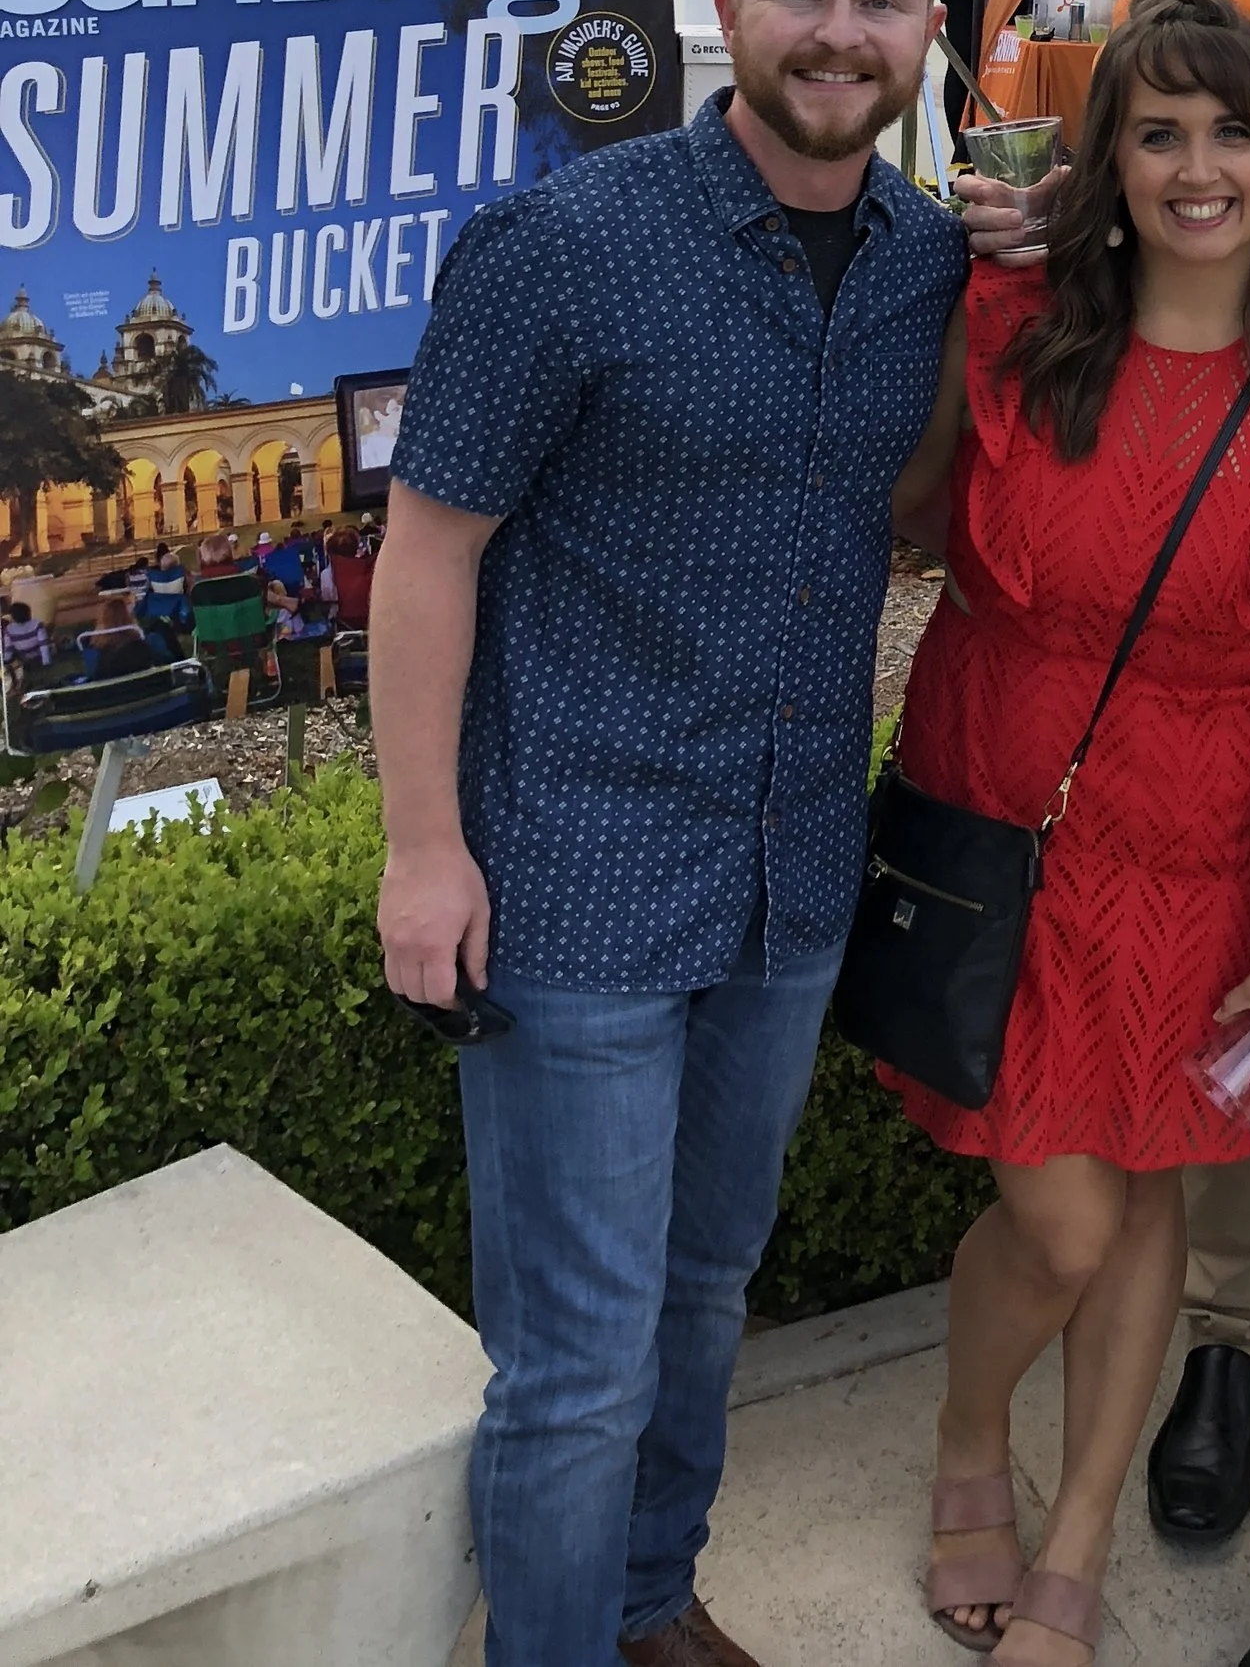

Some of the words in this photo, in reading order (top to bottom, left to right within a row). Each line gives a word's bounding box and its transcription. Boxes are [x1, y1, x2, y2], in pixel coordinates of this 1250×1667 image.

[0, 17, 100, 38] AGAZINE
[557, 19, 625, 60] INSIDER'S
[555, 62, 576, 83] AN
[621, 33, 649, 78] GUIDE
[0, 16, 523, 249] SUMMER
[223, 208, 452, 334] BUCKET
